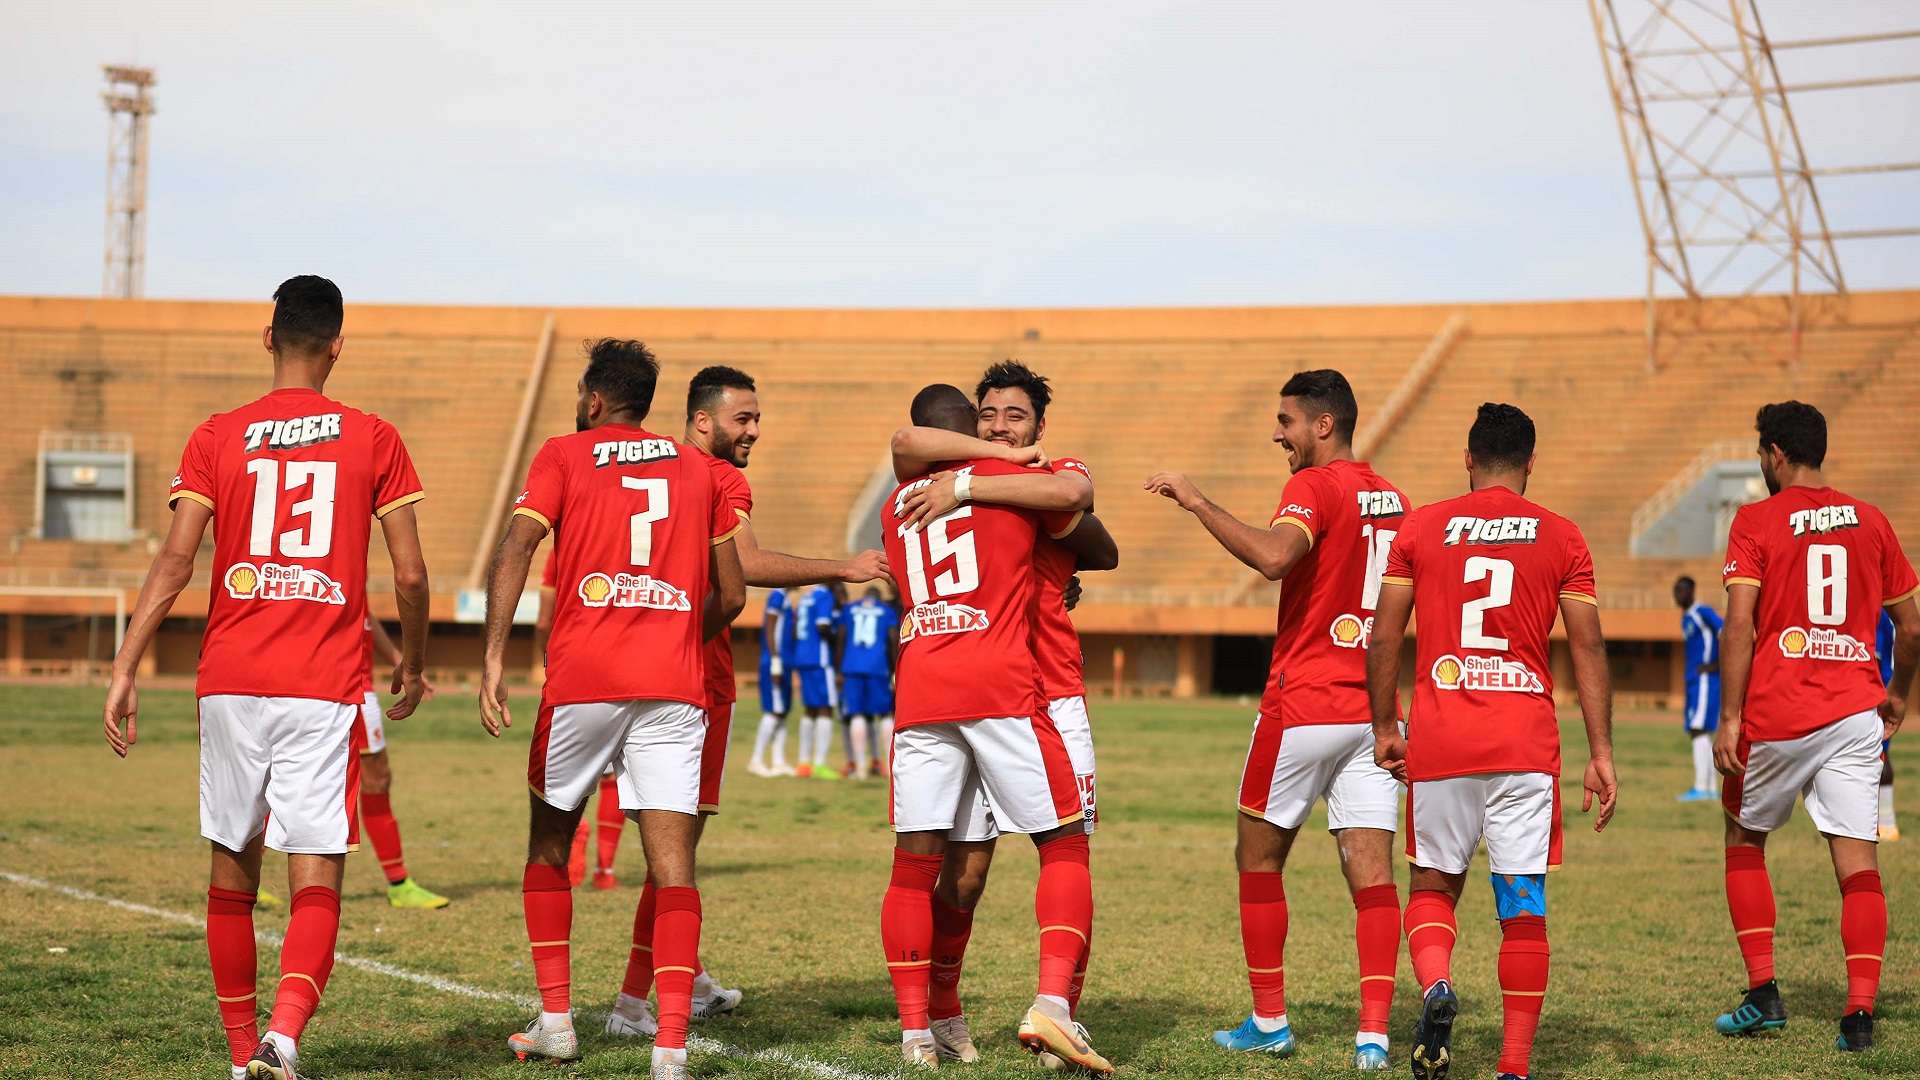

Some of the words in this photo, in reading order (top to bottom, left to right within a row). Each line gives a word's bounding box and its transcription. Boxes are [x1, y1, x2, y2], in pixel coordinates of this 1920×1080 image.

[244, 413, 342, 452] TIGER
[592, 438, 679, 469] TIGER
[247, 458, 337, 558] 13
[621, 475, 669, 567] 7
[1443, 516, 1540, 546] TIGER
[1789, 504, 1860, 537] TIGER
[897, 505, 980, 607] 15
[264, 565, 300, 580] Shell
[616, 575, 649, 589] Shell
[263, 579, 342, 602] HELIX
[1806, 543, 1848, 626] 8
[615, 588, 687, 608] HELIX
[1460, 555, 1515, 651] 2
[916, 604, 946, 618] Shell
[918, 613, 987, 634] HELIX
[1811, 629, 1835, 643] Shell
[1811, 642, 1868, 659] HELIX
[1466, 658, 1501, 671] Shell
[1466, 671, 1540, 689] HELIX
